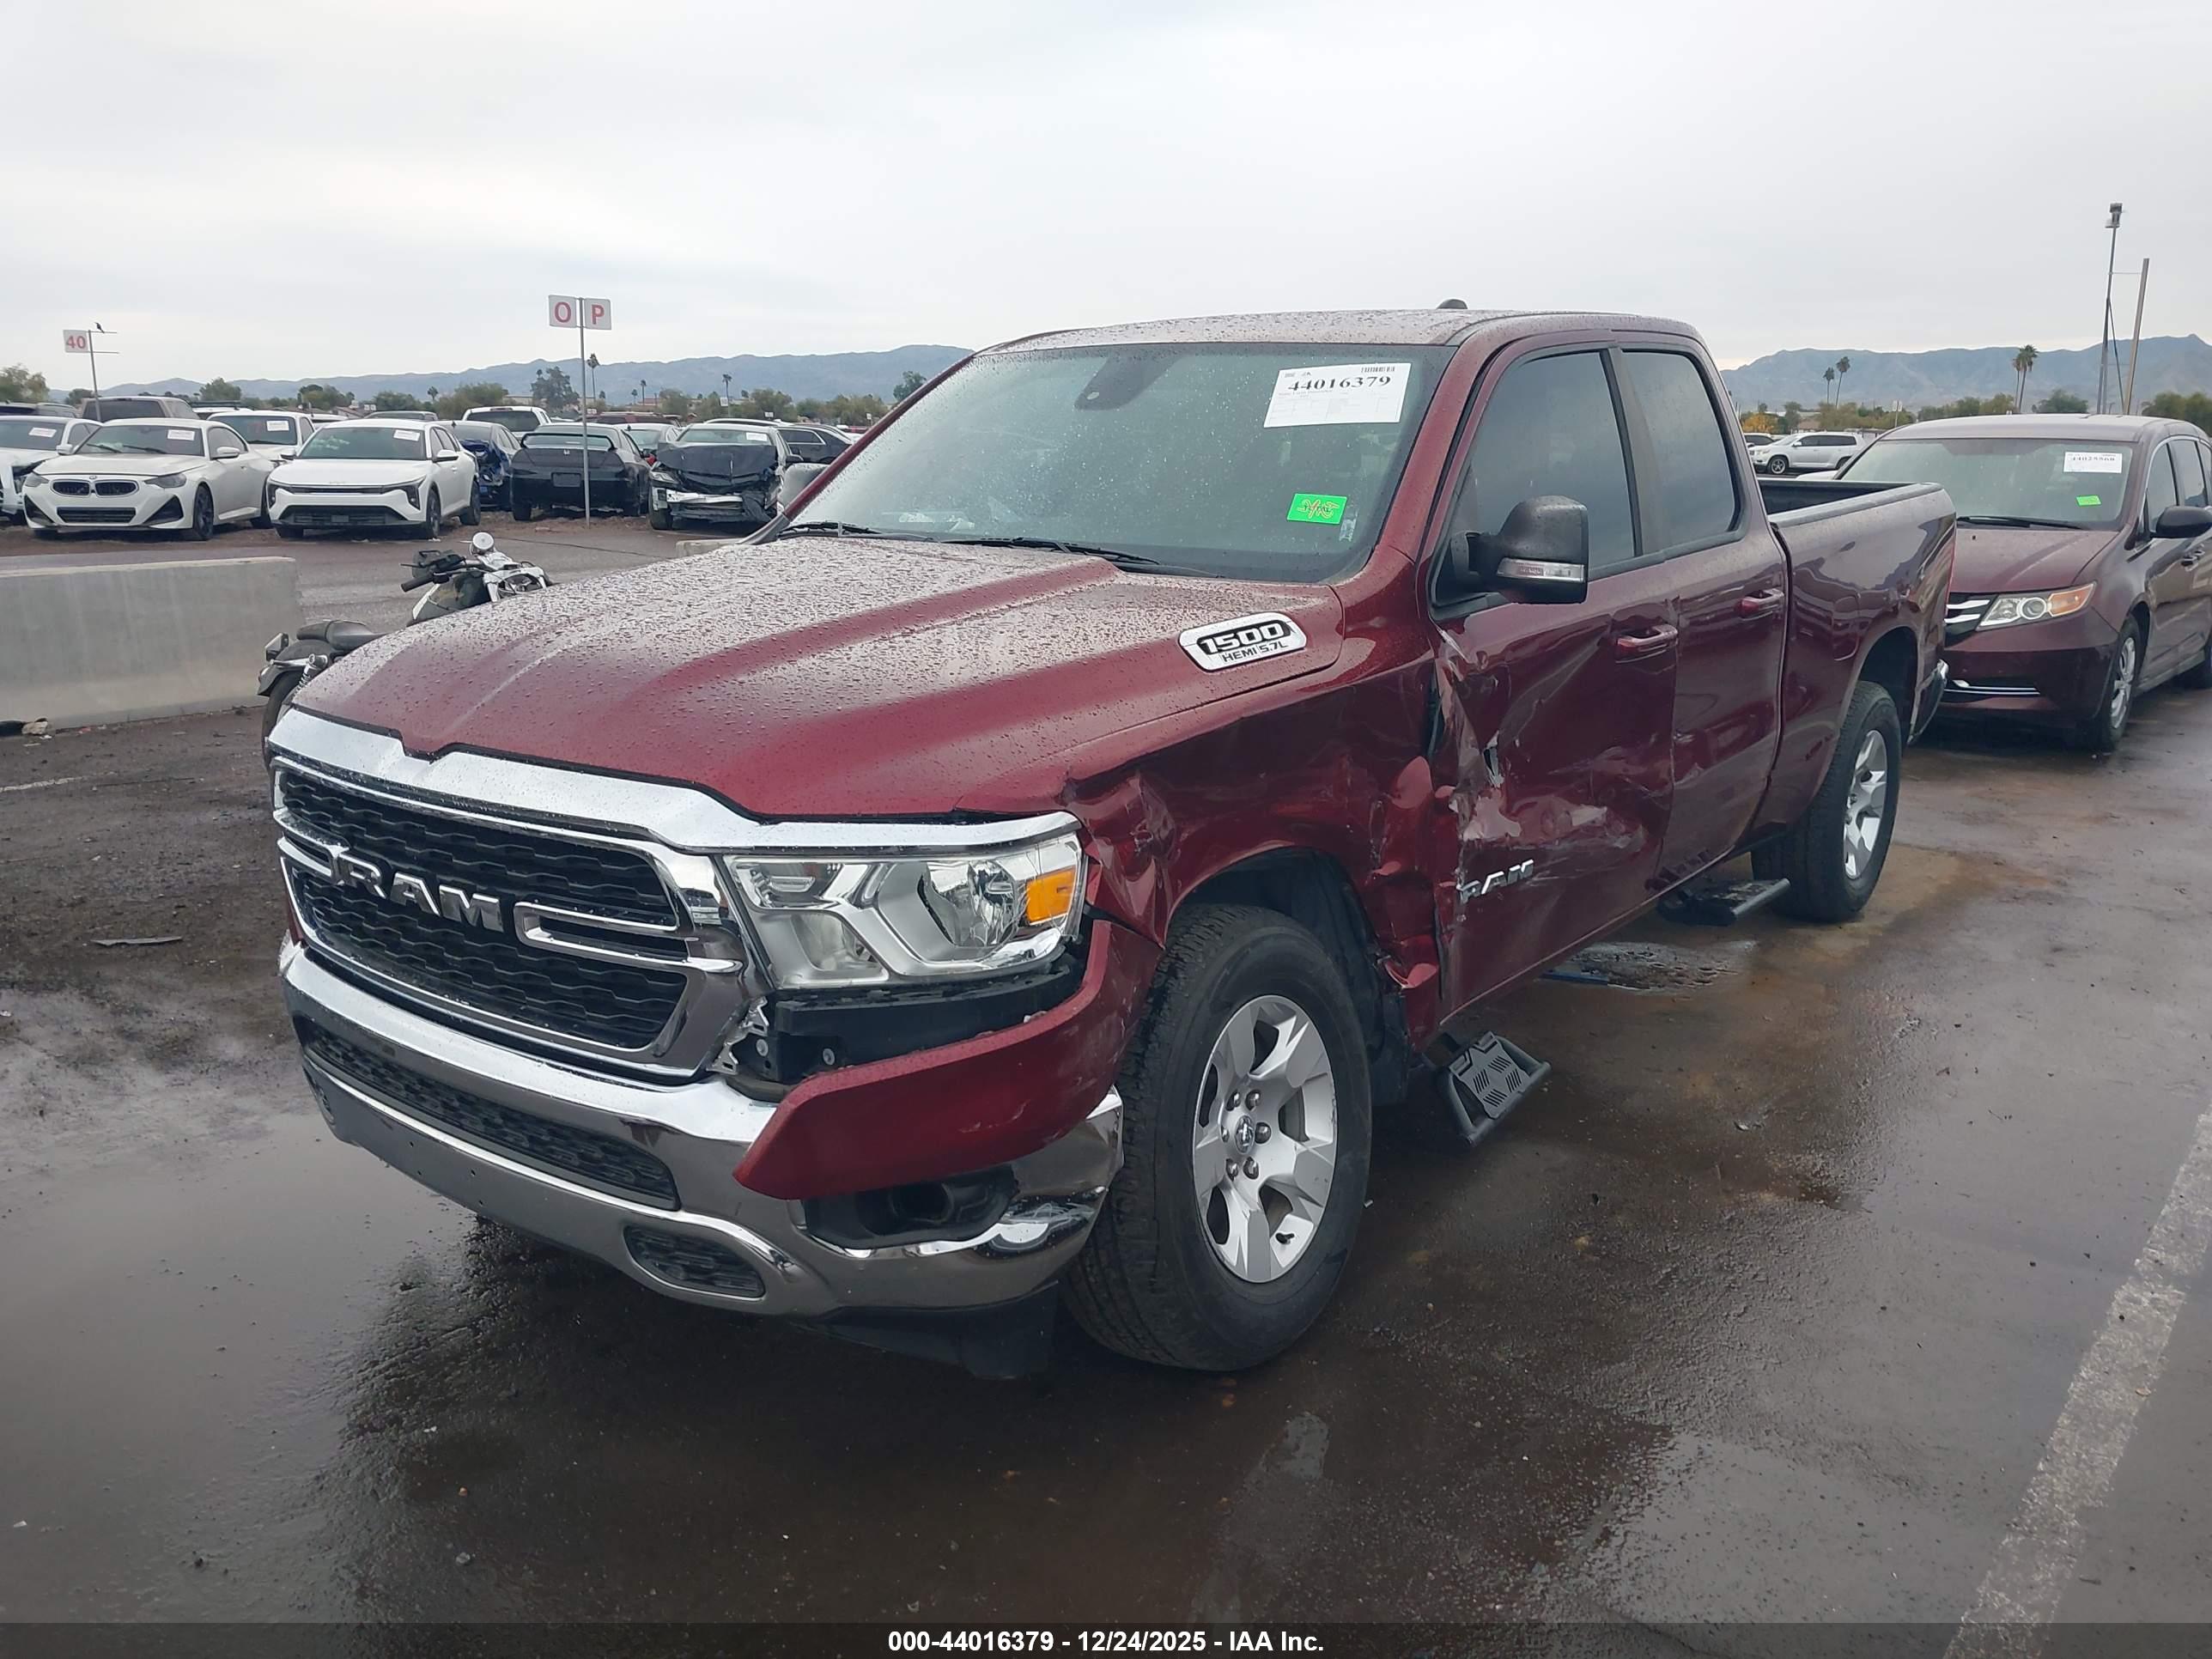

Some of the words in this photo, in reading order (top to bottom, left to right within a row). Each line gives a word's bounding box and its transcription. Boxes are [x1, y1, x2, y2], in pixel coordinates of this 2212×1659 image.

[554, 301, 572, 324] O
[591, 304, 605, 325] P
[66, 335, 87, 349] 40
[1287, 375, 1391, 392] 44016379
[1201, 623, 1285, 653] 1500
[1221, 647, 1258, 663] HEMI
[1260, 641, 1289, 653] 5.7L
[1457, 859, 1534, 904] RAM
[331, 853, 505, 933] RAM
